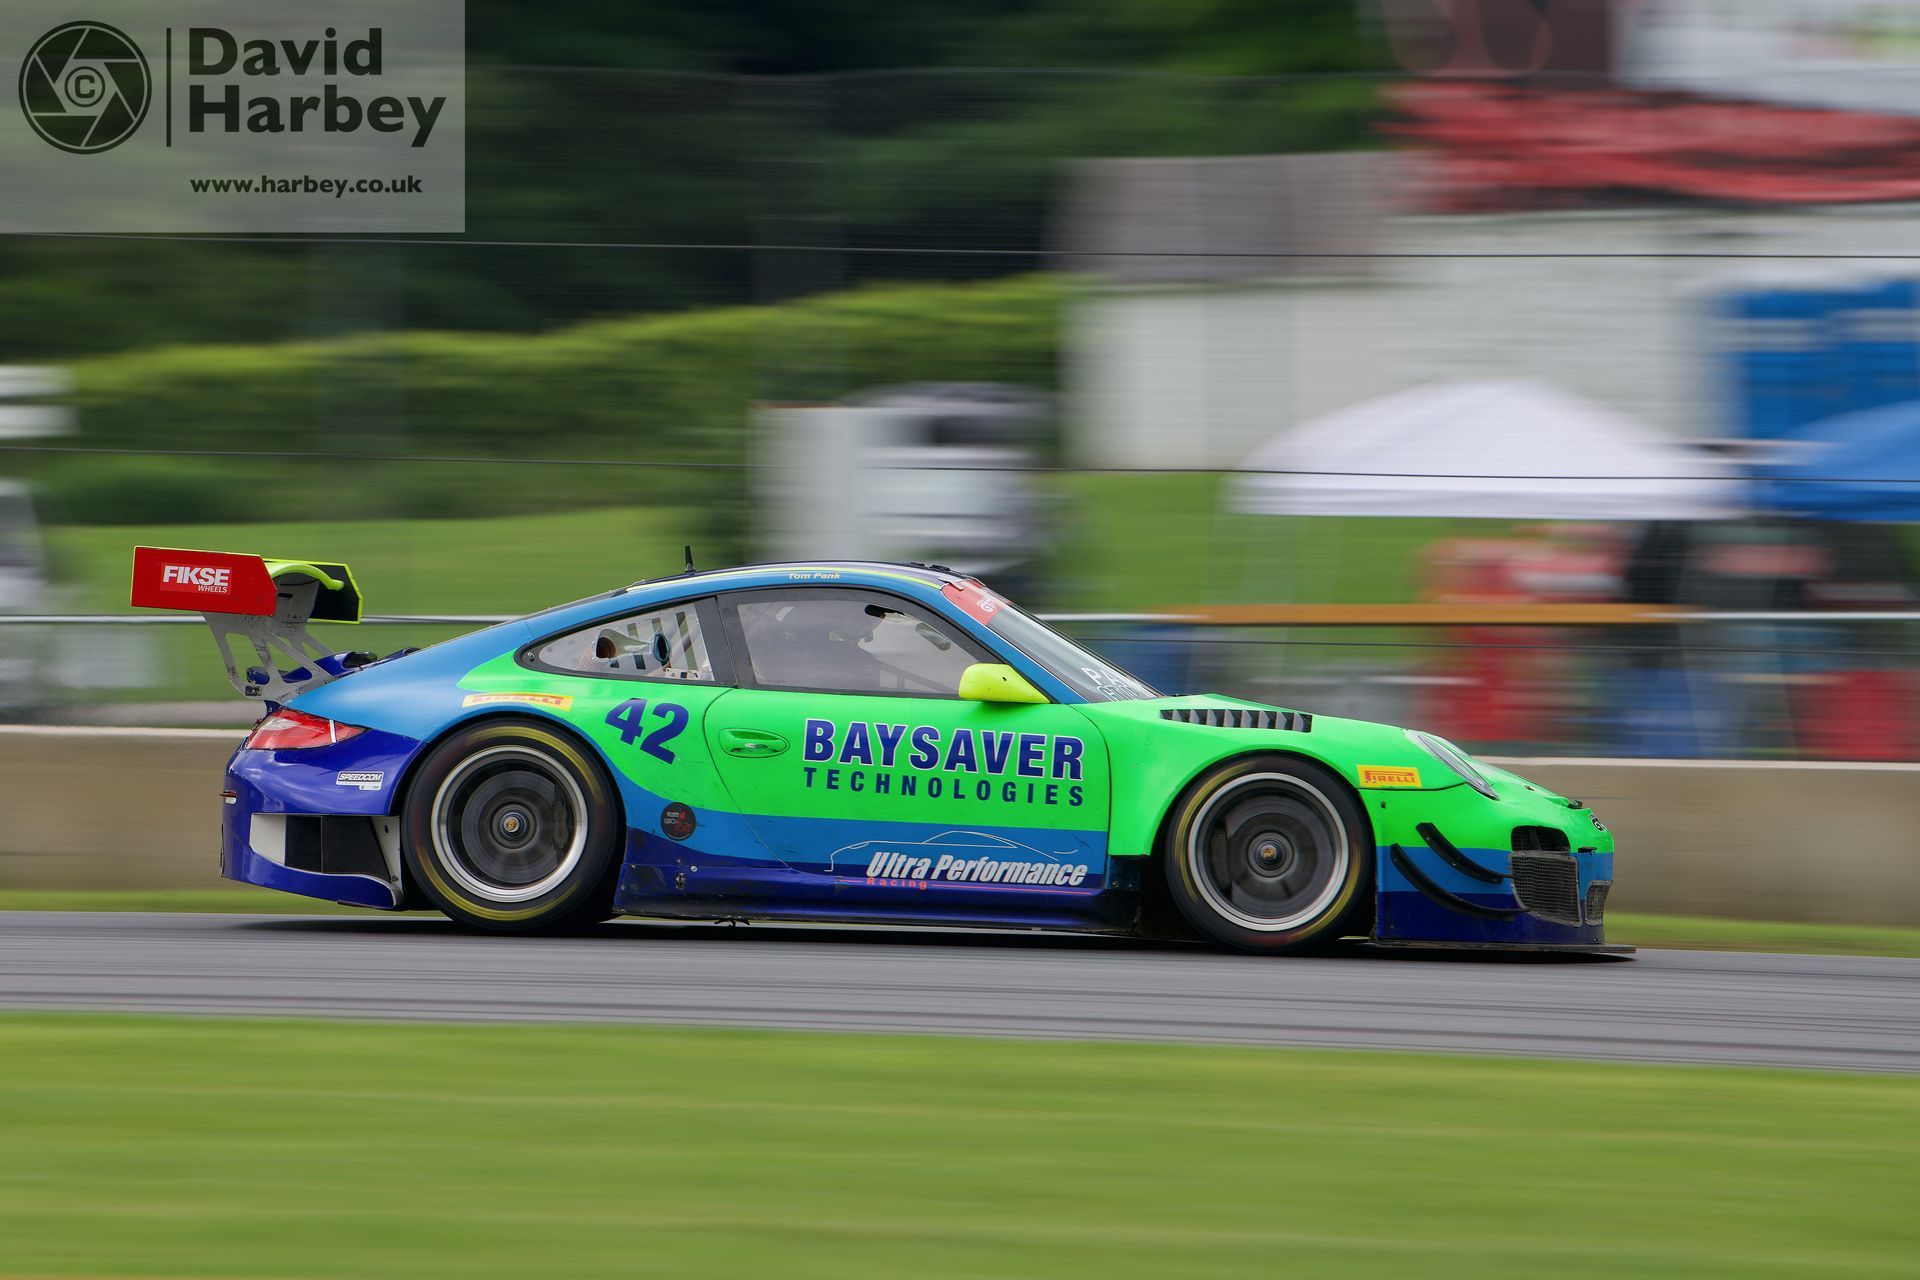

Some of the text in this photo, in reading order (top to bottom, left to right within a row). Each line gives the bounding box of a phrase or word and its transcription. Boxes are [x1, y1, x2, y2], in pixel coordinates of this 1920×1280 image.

[163, 565, 230, 586] FIKSE
[813, 571, 840, 580] Pank
[197, 585, 228, 594] WHEELS
[604, 697, 690, 766] 42
[803, 718, 1084, 781] BAYSAVER
[339, 773, 382, 781] SPEEDCOM
[1364, 770, 1416, 783] PIRELLI
[804, 767, 1084, 806] TECHNOLOGIES
[866, 851, 1089, 887] Ultra Performance
[866, 877, 928, 891] Racing
